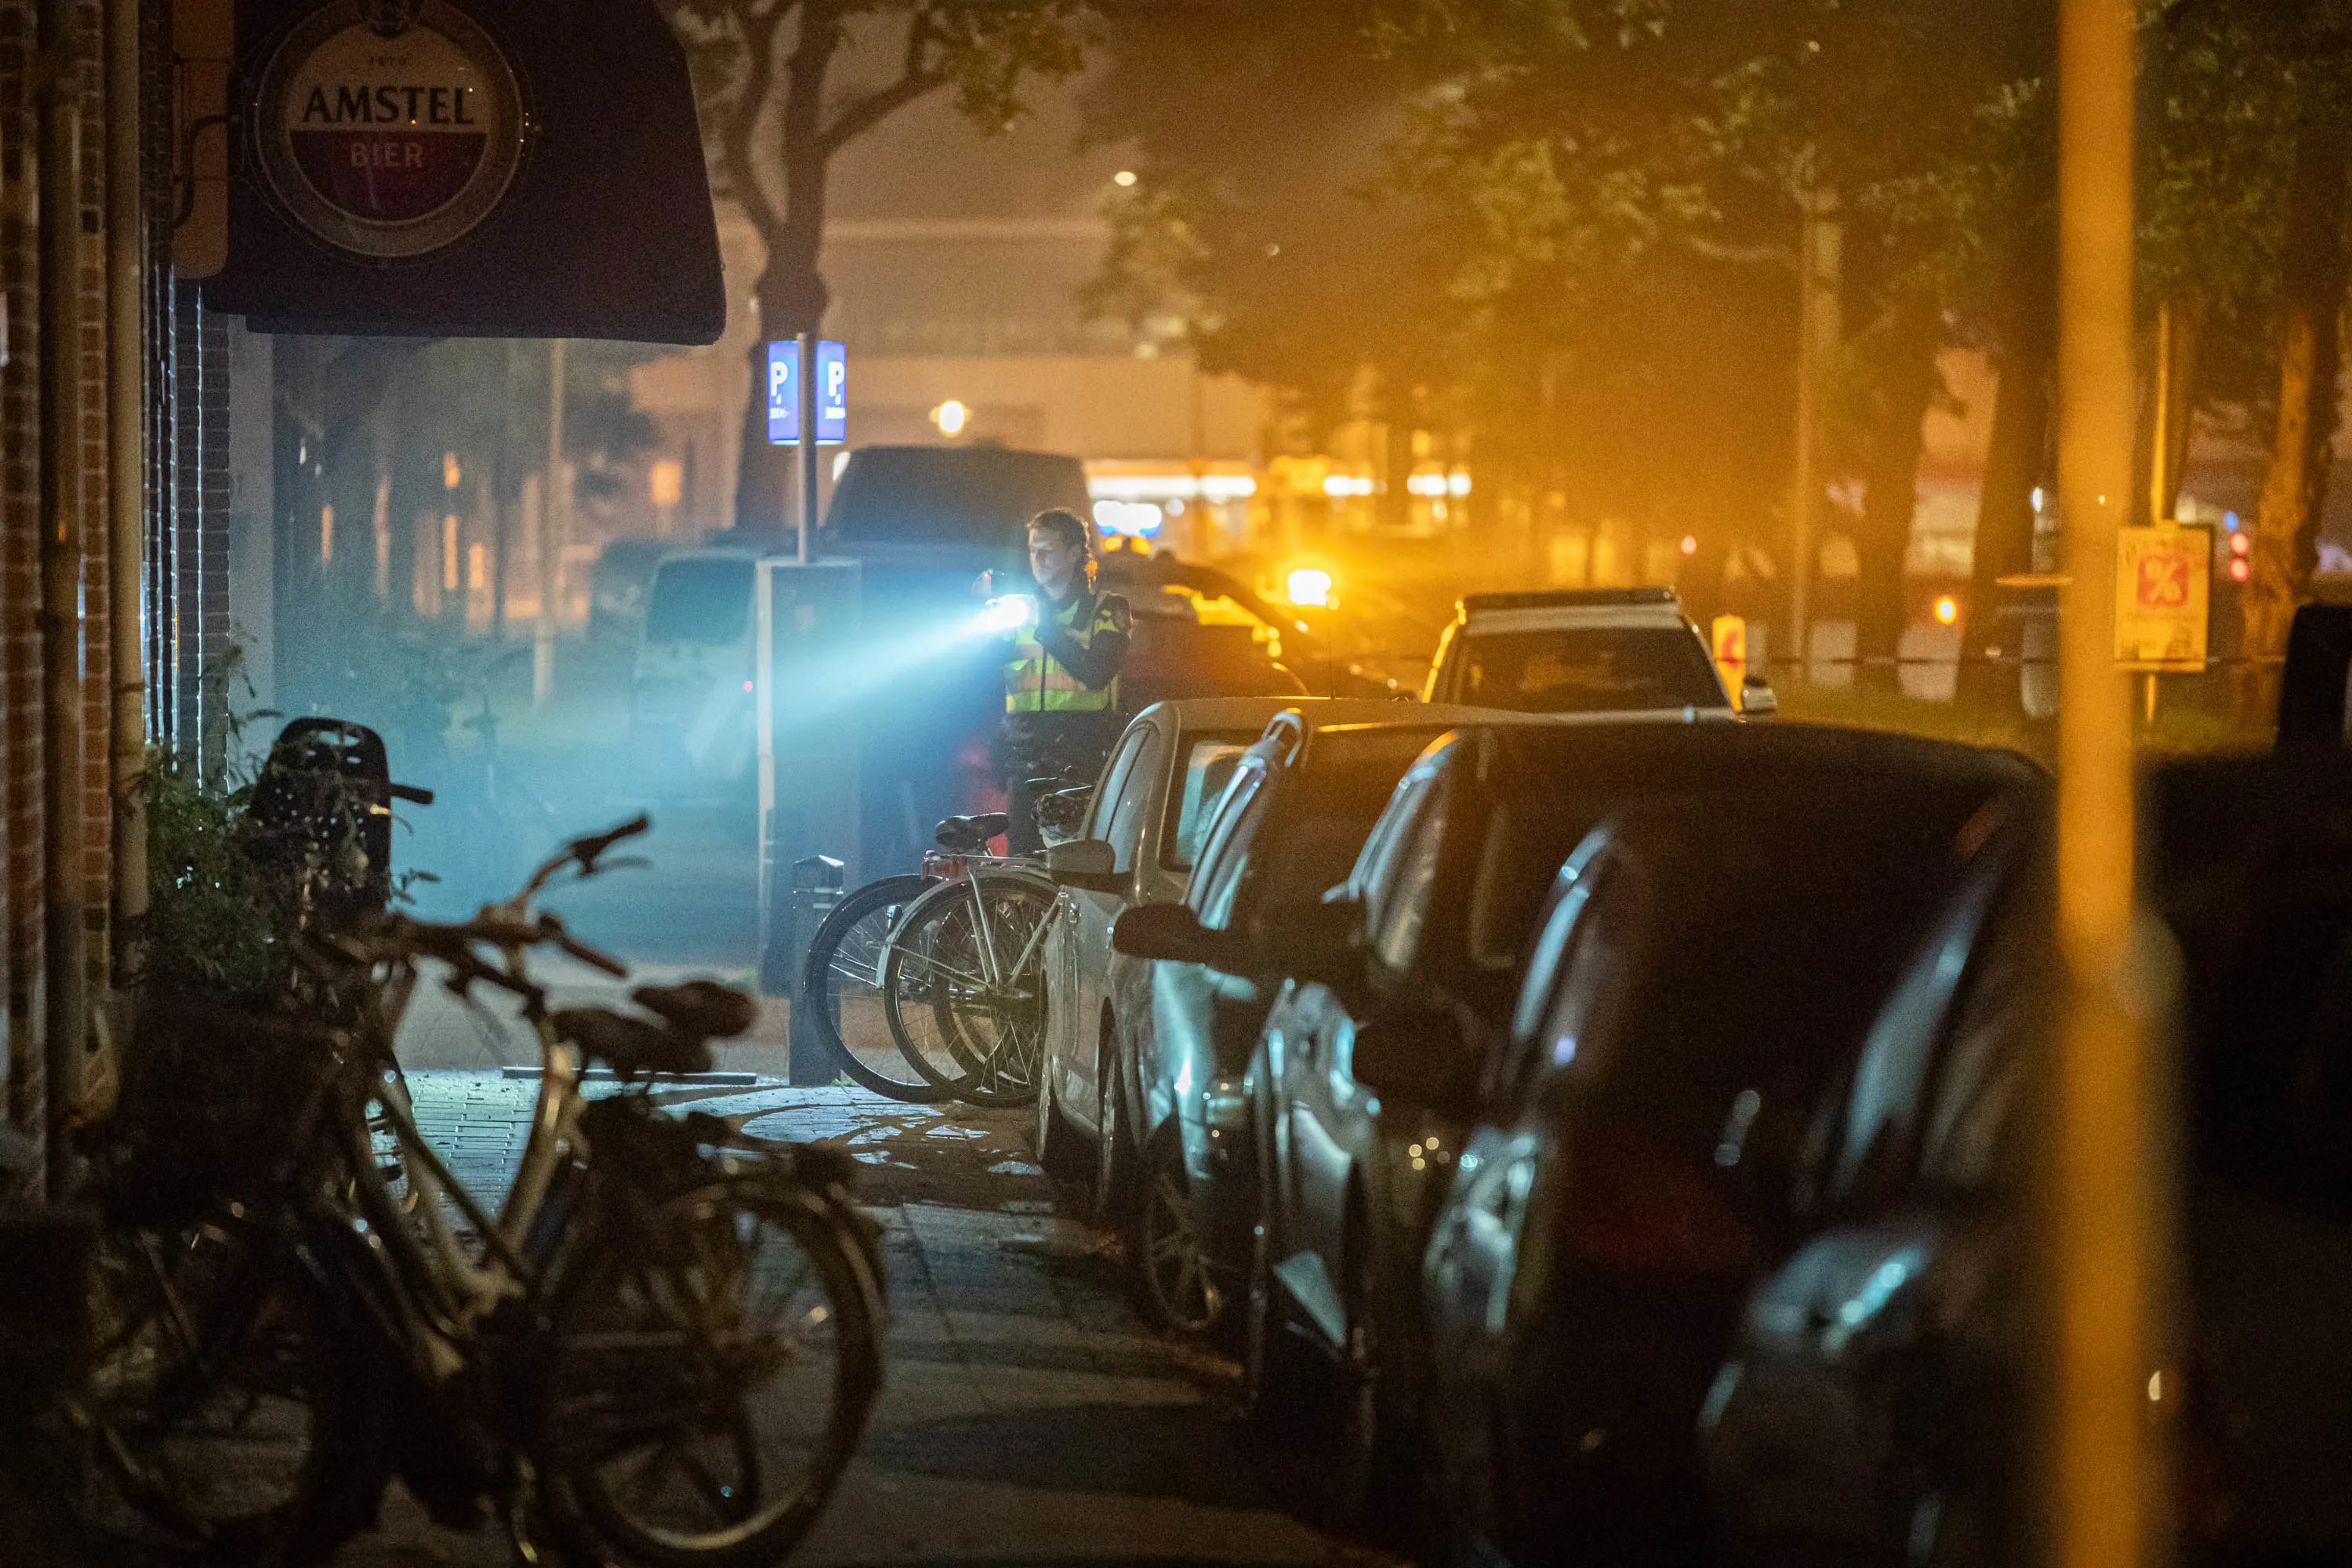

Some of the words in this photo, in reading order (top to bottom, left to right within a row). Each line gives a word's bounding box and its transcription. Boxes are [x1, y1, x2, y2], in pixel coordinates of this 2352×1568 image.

[301, 84, 475, 125] AMSTEL
[350, 141, 423, 169] BIER
[770, 361, 789, 397] P
[827, 361, 845, 397] P
